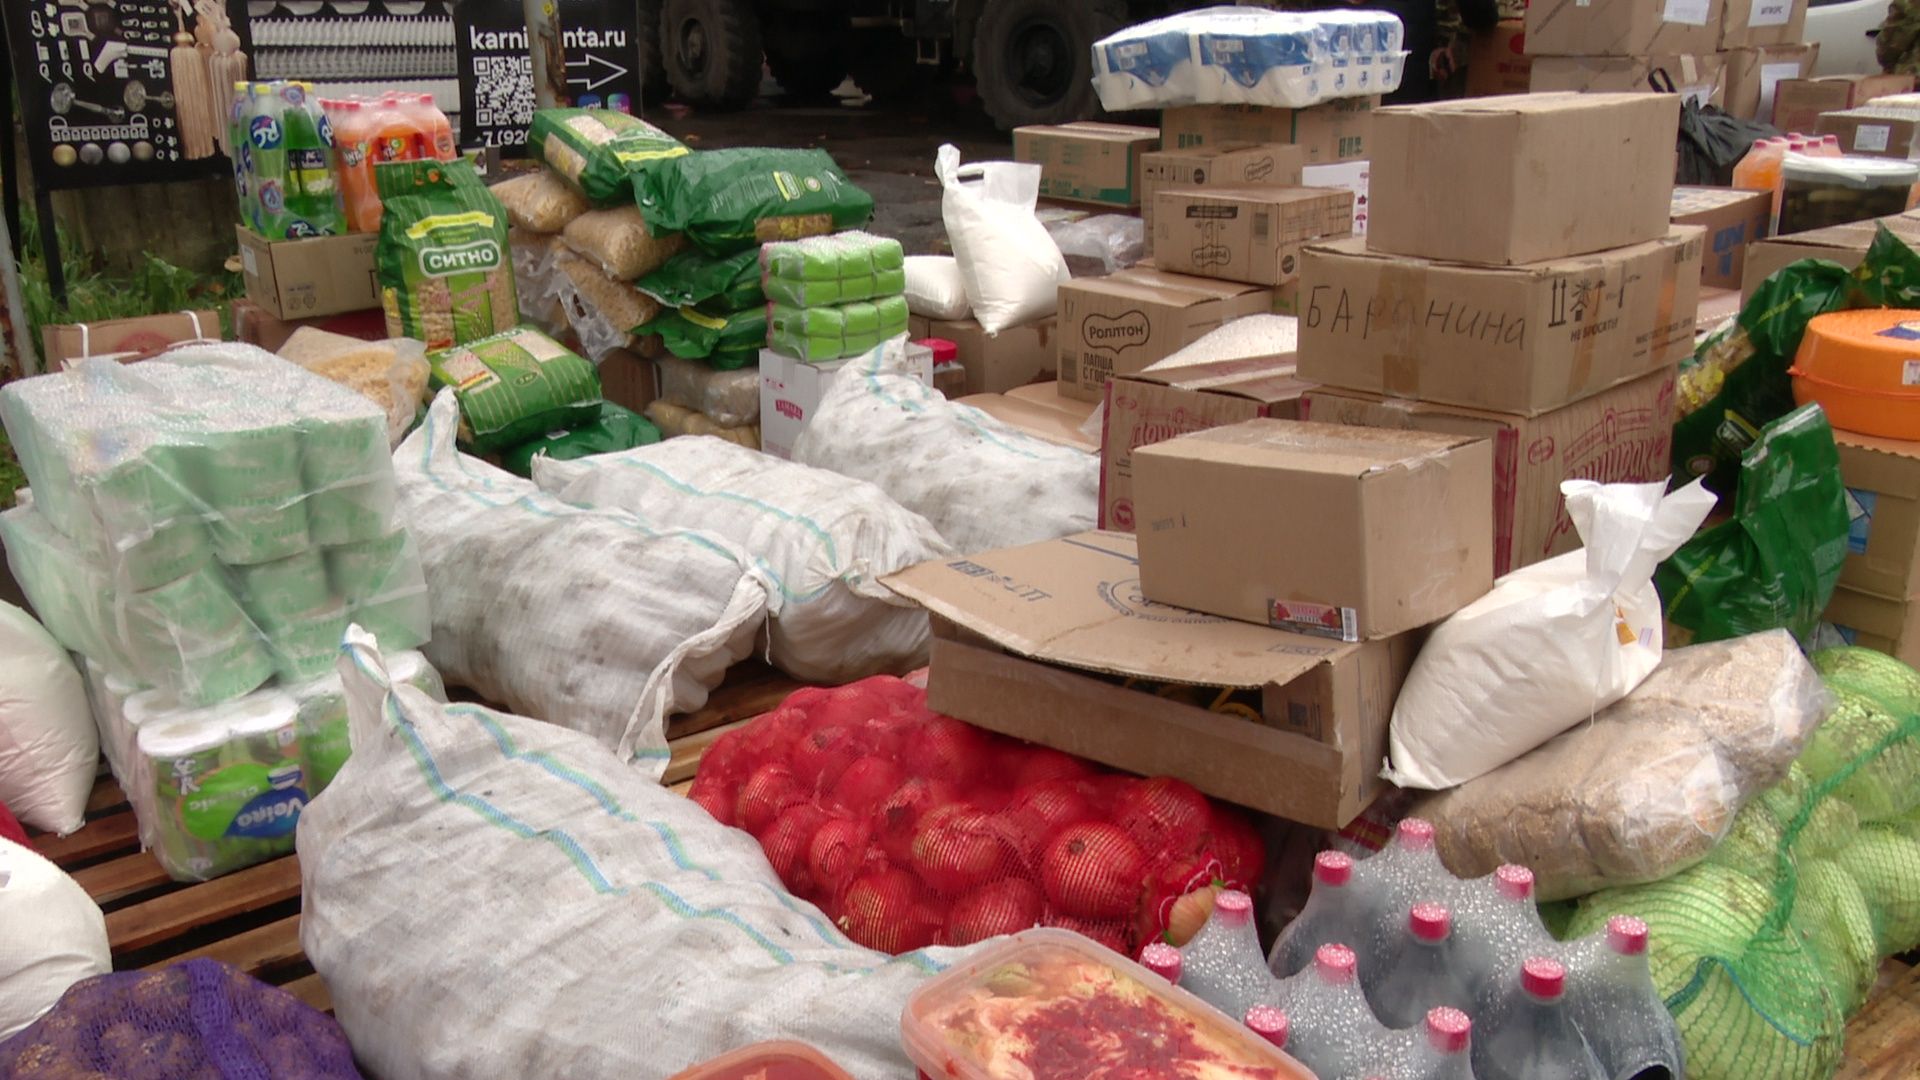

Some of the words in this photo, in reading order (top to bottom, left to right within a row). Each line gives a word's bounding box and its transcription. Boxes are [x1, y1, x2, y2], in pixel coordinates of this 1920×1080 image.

[429, 248, 494, 269] СИТНО
[1083, 352, 1113, 370] ЛАПША
[1090, 368, 1116, 383] ГОВ
[236, 797, 304, 828] Veiro
